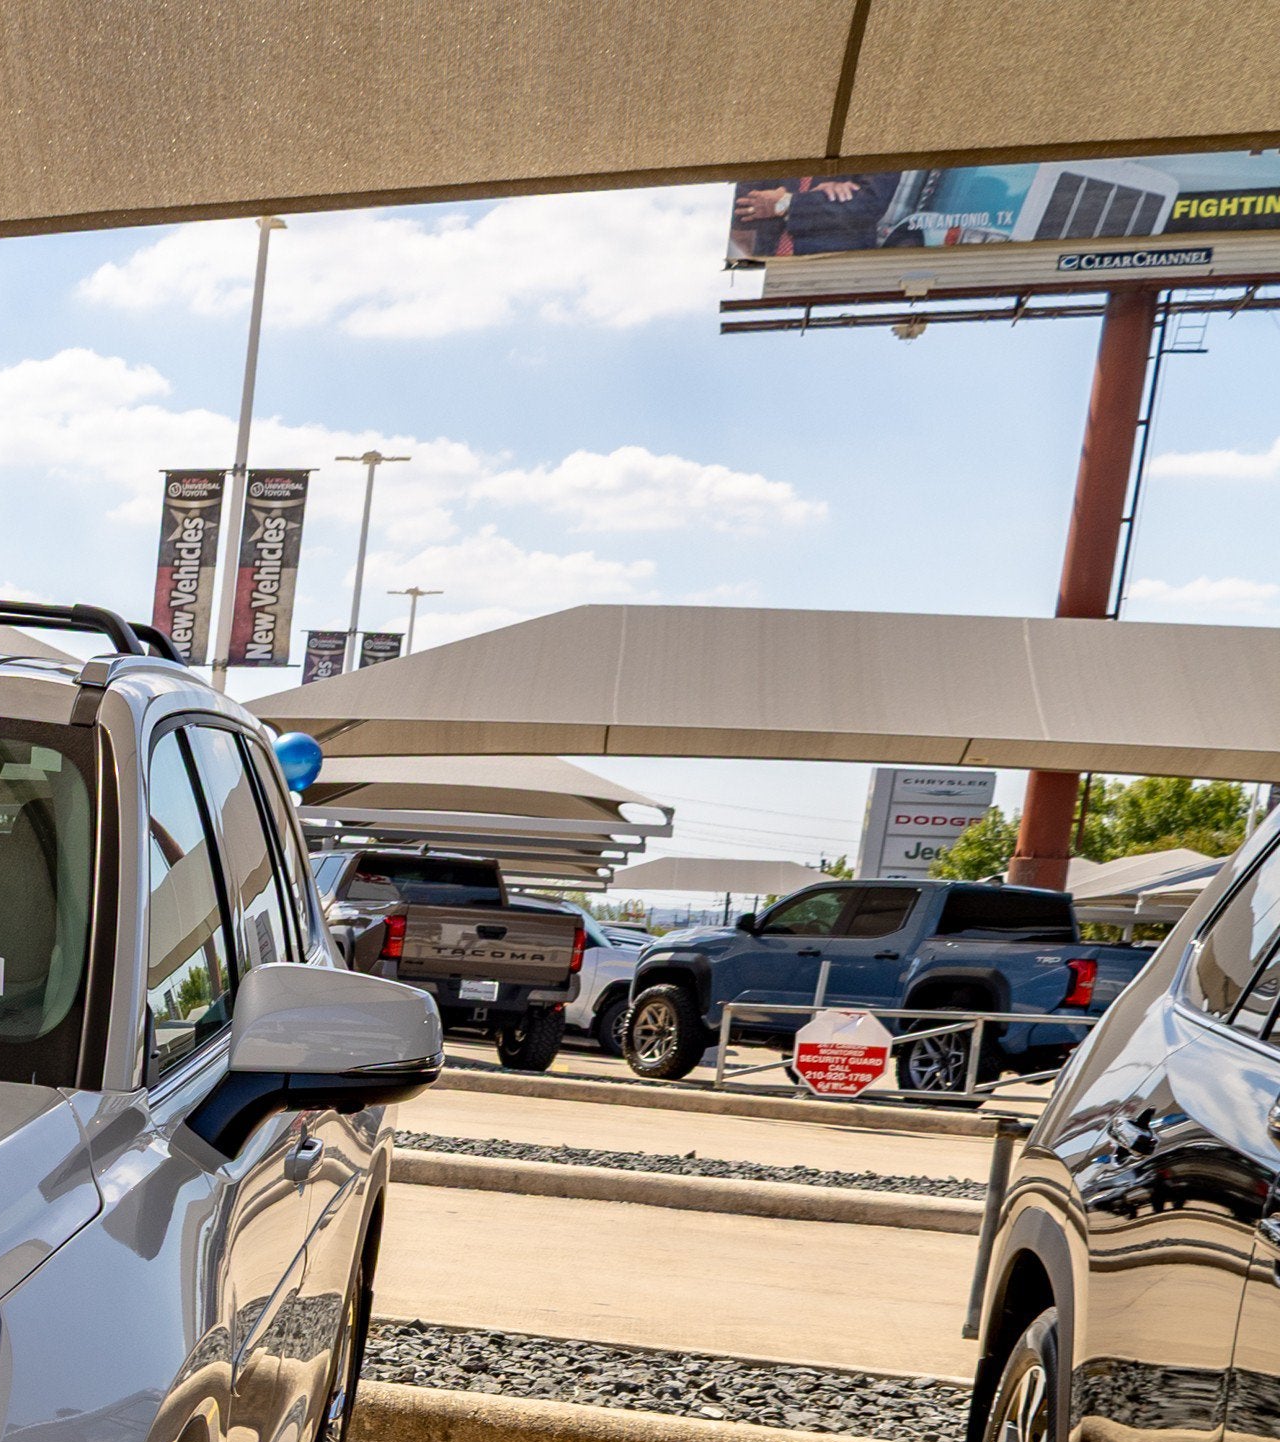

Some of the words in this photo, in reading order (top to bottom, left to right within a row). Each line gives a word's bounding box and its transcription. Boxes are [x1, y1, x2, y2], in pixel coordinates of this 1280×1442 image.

[907, 213, 932, 230] SAN
[935, 211, 992, 228] ANTONIO,
[996, 211, 1015, 226] TX
[170, 517, 205, 608] Vehicles
[251, 517, 288, 608] Vehicles
[244, 611, 276, 660] New
[903, 778, 988, 787] CHRYSLER
[432, 946, 545, 961] TACOMA
[1035, 956, 1062, 964] TRD
[799, 1054, 848, 1064] SECURITY
[848, 1057, 883, 1067] GUARD
[828, 1064, 851, 1072] CALL
